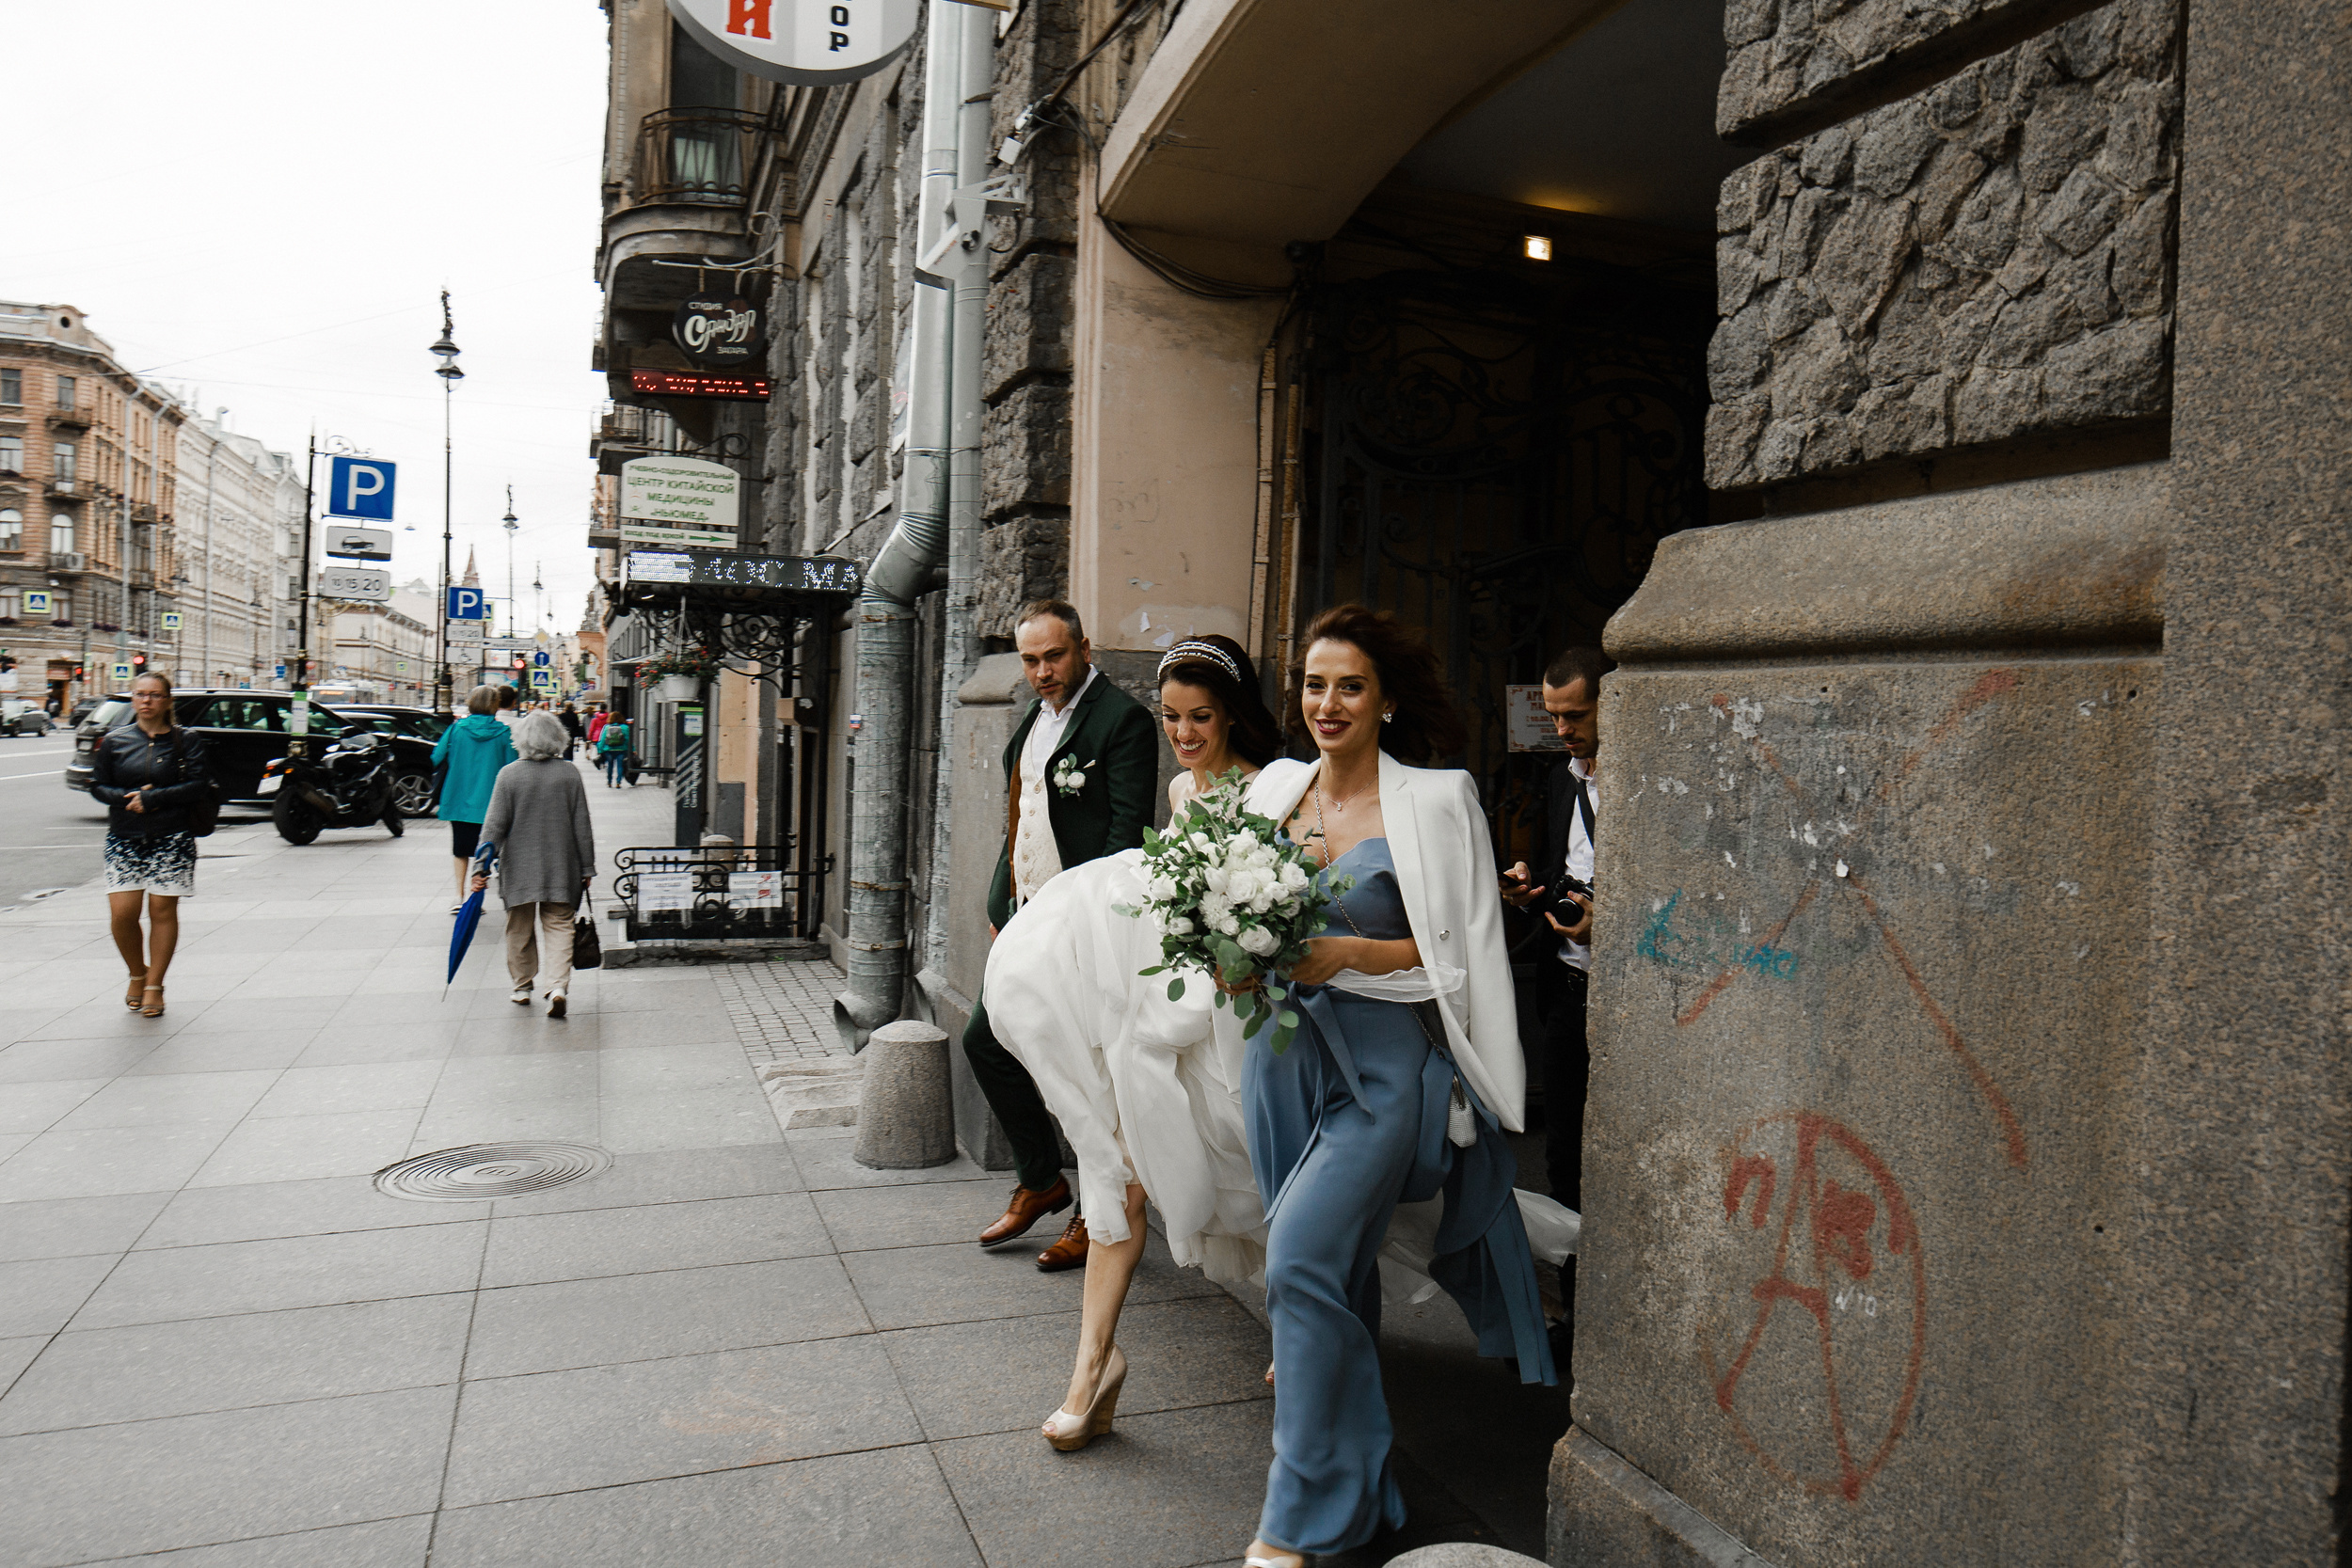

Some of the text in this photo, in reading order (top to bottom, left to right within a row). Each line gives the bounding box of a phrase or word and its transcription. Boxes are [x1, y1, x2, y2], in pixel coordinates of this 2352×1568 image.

[829, 0, 850, 52] ОР
[346, 464, 386, 511] P
[627, 476, 735, 494] ЦЕНТР КИТАЙСКОЙ
[646, 492, 715, 506] МЕДИЦИНЫ
[345, 578, 358, 589] 15
[363, 578, 381, 592] 20
[457, 591, 479, 616] P
